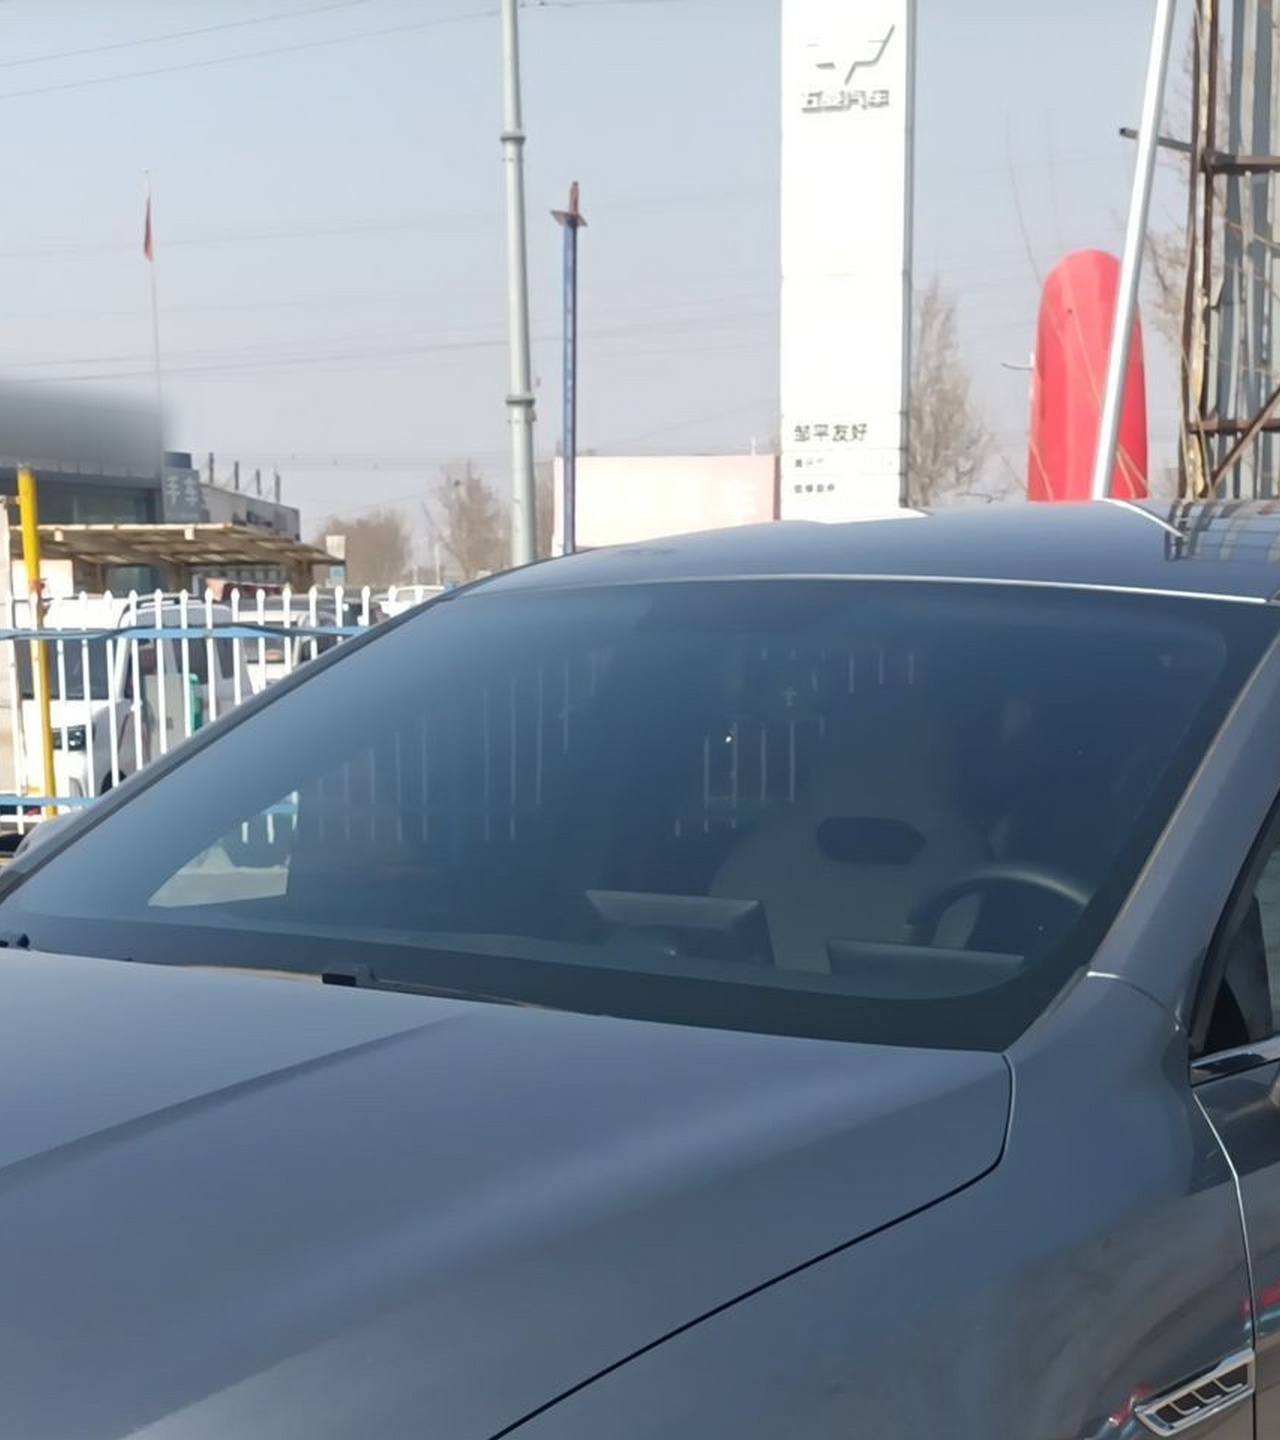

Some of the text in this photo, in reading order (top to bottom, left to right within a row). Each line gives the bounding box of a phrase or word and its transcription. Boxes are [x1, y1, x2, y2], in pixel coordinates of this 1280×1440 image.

[801, 90, 890, 114] 五汽车
[794, 423, 867, 443] 邹平友好
